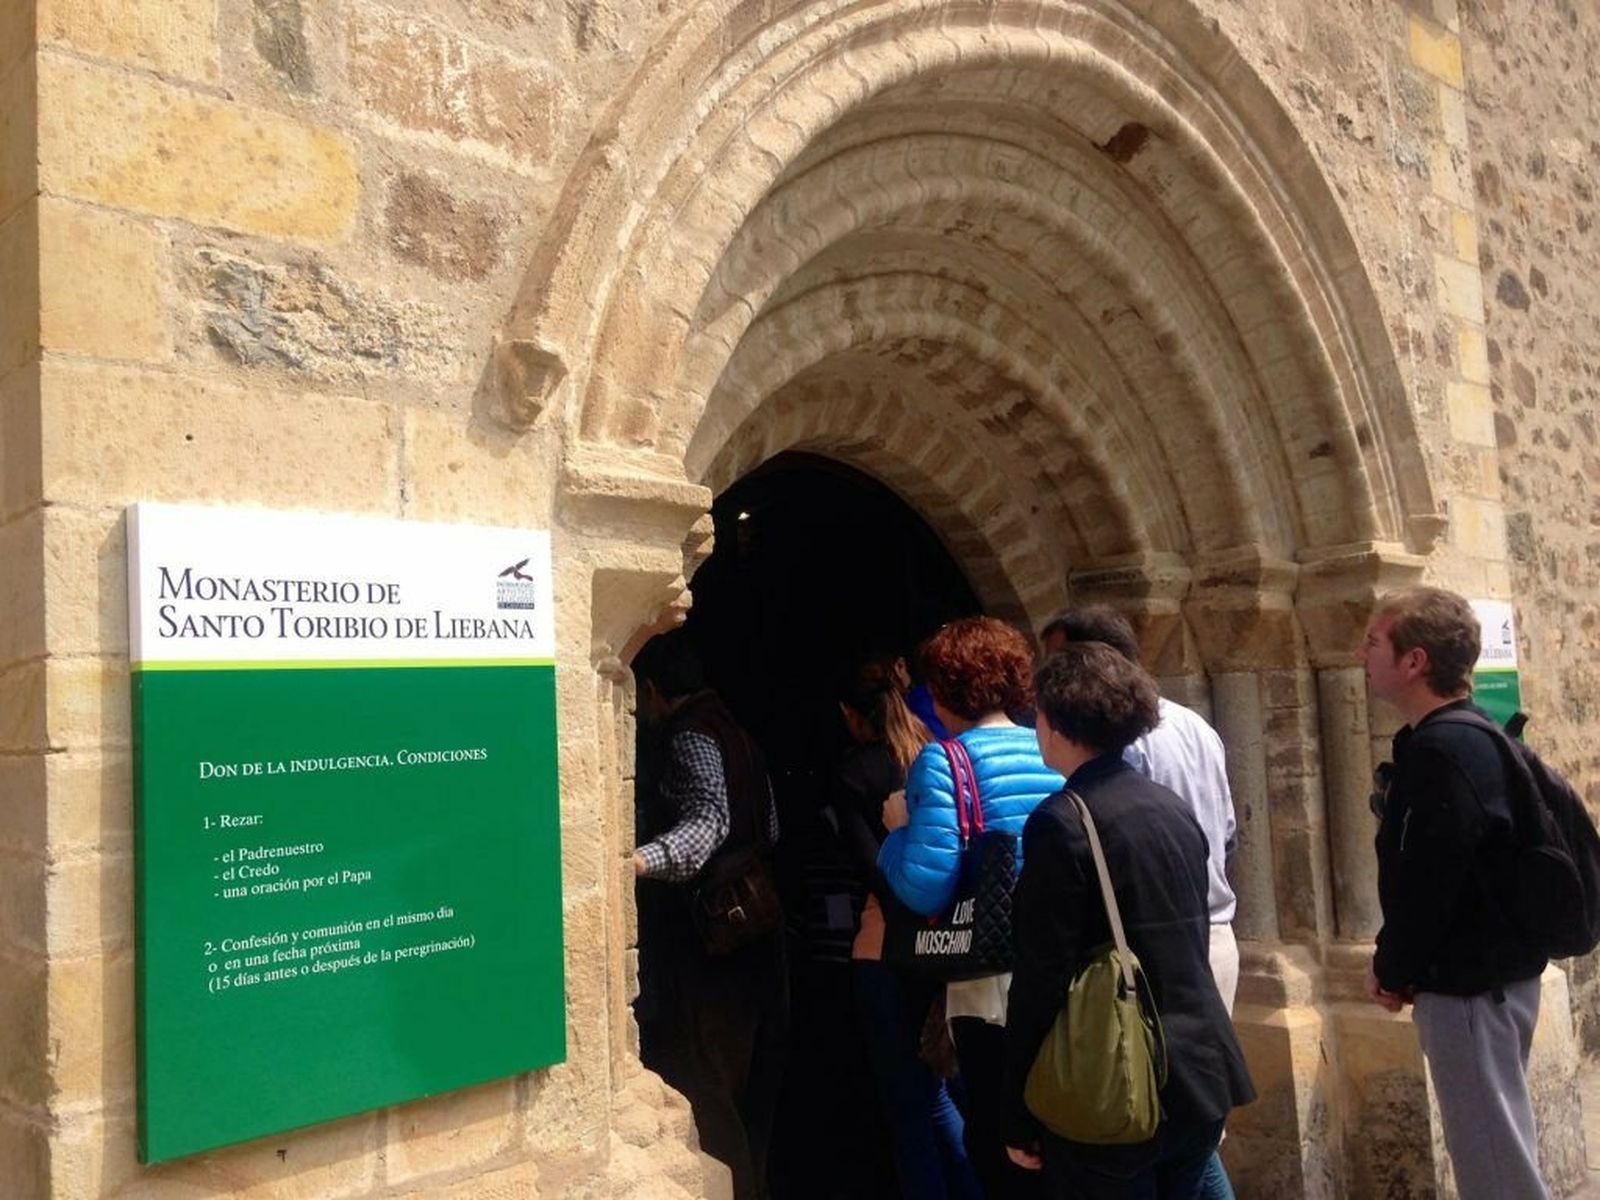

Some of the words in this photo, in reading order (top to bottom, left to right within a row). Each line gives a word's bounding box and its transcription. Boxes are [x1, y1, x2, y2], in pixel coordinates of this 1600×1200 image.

[158, 566, 360, 604] MONASTERIO
[367, 583, 401, 605] DE
[158, 604, 265, 639] SANTO
[270, 607, 388, 639] TORIBIO
[395, 617, 428, 639] DE
[433, 610, 534, 639] LIEBANA
[199, 761, 238, 779] DON
[242, 763, 263, 776] DE
[267, 761, 287, 774] LA
[290, 755, 394, 773] INDULGENCIA.
[396, 748, 488, 765] CONDICIONES
[220, 814, 263, 828] Rezar:
[222, 849, 235, 864] el
[238, 843, 324, 862] Padrenuestro
[222, 867, 235, 881] el
[238, 863, 280, 879] Credo
[223, 886, 248, 899] una
[250, 878, 300, 895] oración
[302, 876, 324, 893] por
[327, 871, 339, 886] el
[342, 870, 372, 885] Papa
[952, 897, 976, 924] LOVE
[221, 931, 289, 953] Confesión
[291, 931, 300, 946] y
[301, 920, 364, 941] comunión
[365, 919, 381, 931] en
[382, 914, 394, 928] el
[396, 911, 435, 926] mismo
[915, 929, 973, 954] MOSCHINO
[208, 962, 218, 973] o
[224, 958, 241, 971] en
[244, 954, 270, 968] una
[272, 945, 307, 963] fecha
[309, 939, 361, 959] próxima
[208, 974, 231, 993] (15
[263, 966, 298, 982] antes
[300, 965, 310, 976] o
[311, 955, 362, 977] después
[363, 951, 378, 965] de
[380, 949, 392, 962] la
[394, 934, 476, 962] peregrinación)
